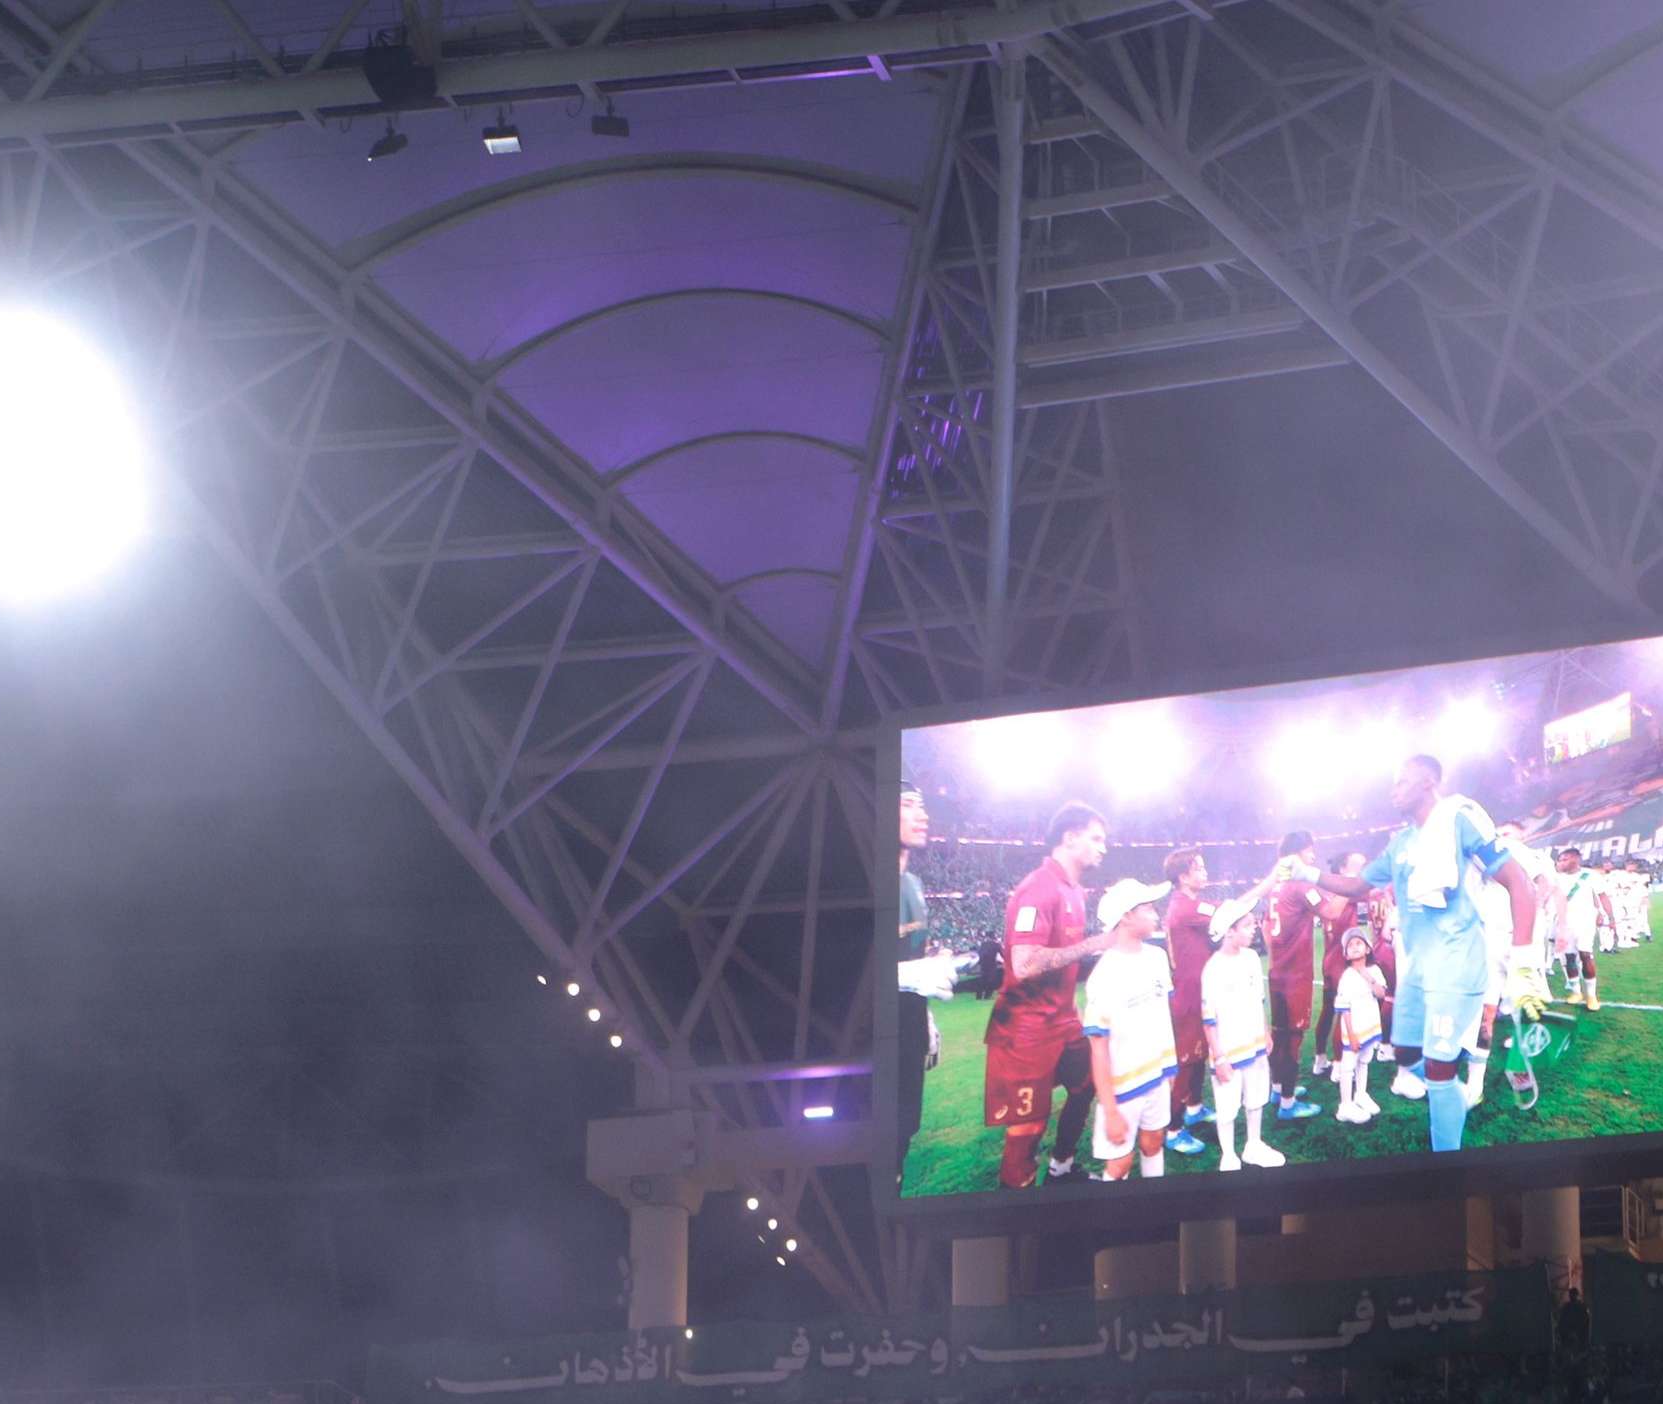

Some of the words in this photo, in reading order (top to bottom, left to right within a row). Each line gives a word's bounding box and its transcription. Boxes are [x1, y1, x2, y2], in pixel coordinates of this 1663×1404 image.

[1016, 1087, 1034, 1116] 3
[1227, 1290, 1376, 1364] في
[1386, 1285, 1487, 1331] كتبت
[676, 1326, 810, 1395] في
[820, 1327, 949, 1377] وحفرت
